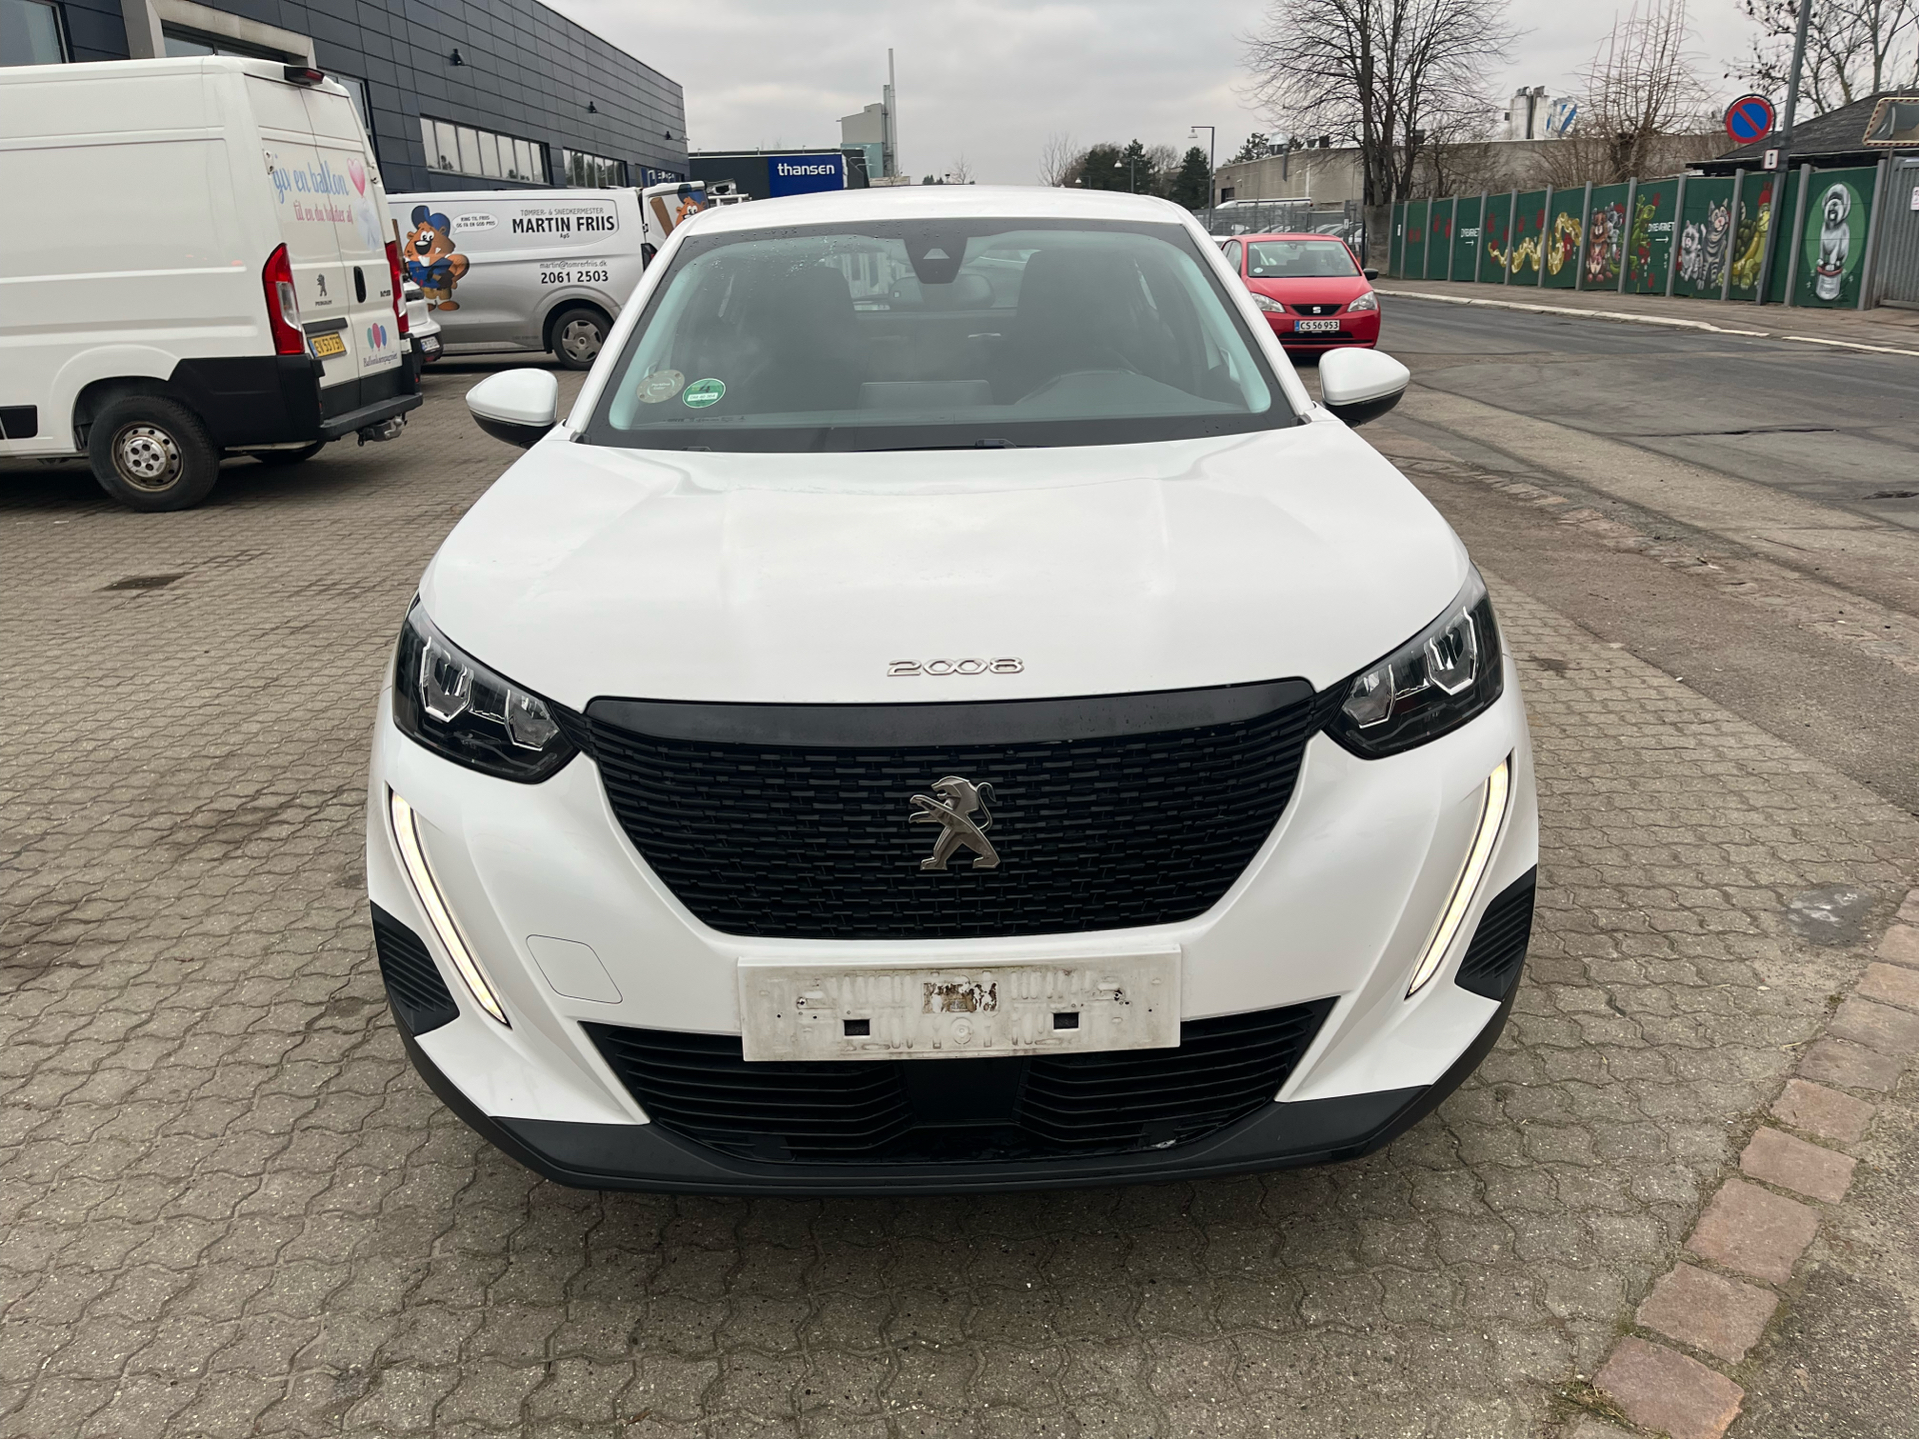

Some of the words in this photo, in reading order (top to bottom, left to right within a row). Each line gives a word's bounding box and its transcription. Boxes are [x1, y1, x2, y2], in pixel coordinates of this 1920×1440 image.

[777, 162, 835, 176] thansen
[293, 169, 311, 193] en
[307, 160, 350, 196] ballon
[512, 217, 571, 233] MARTIN
[576, 215, 615, 231] FRIIS
[541, 271, 571, 284] 2061
[577, 270, 609, 283] 2503
[1300, 321, 1311, 330] CS
[1312, 321, 1322, 330] 56
[1323, 321, 1339, 330] 953
[887, 656, 1025, 677] 2008
